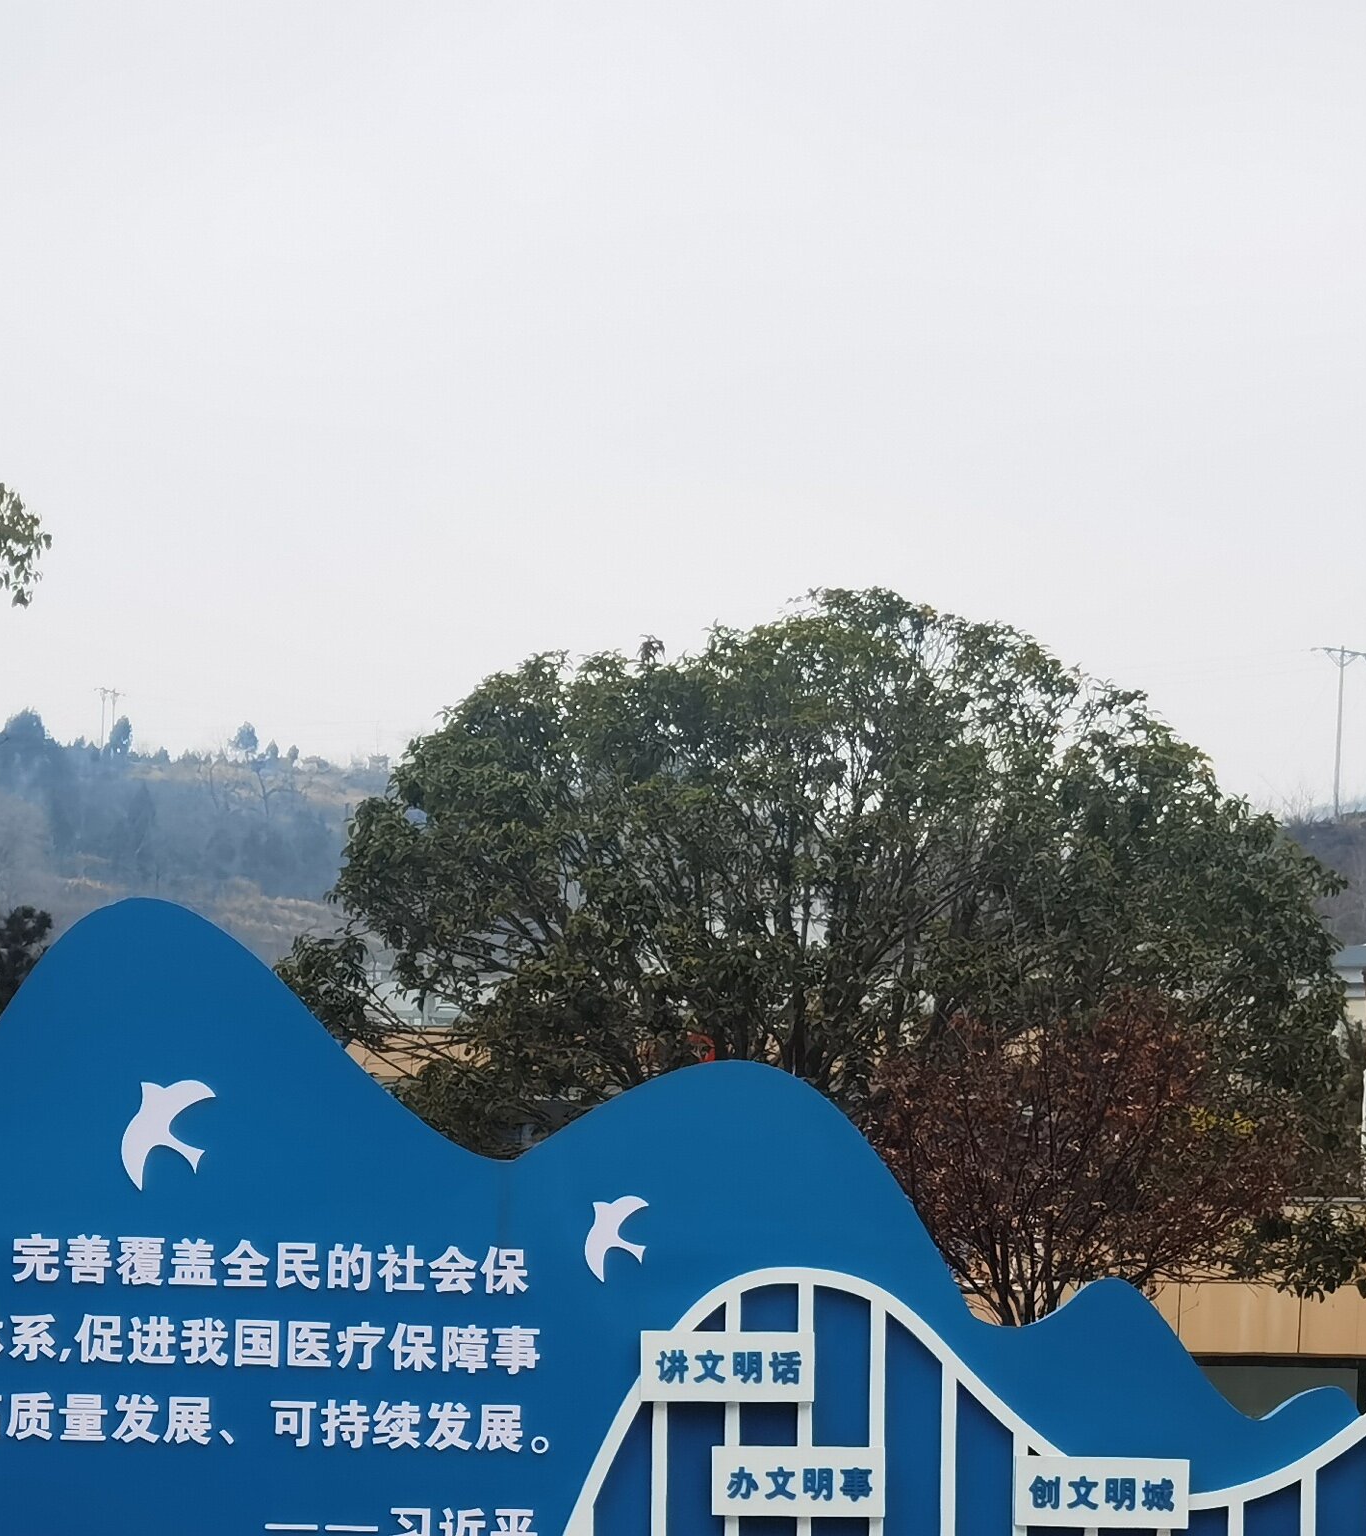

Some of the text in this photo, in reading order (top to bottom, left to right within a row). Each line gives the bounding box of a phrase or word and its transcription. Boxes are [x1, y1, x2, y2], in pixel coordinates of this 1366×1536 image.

[11, 1233, 530, 1295] 完善覆盖全民的社会保
[654, 1349, 803, 1386] 讲文明话
[725, 1466, 874, 1503] 办文明事
[1028, 1475, 1176, 1513] 创文明城
